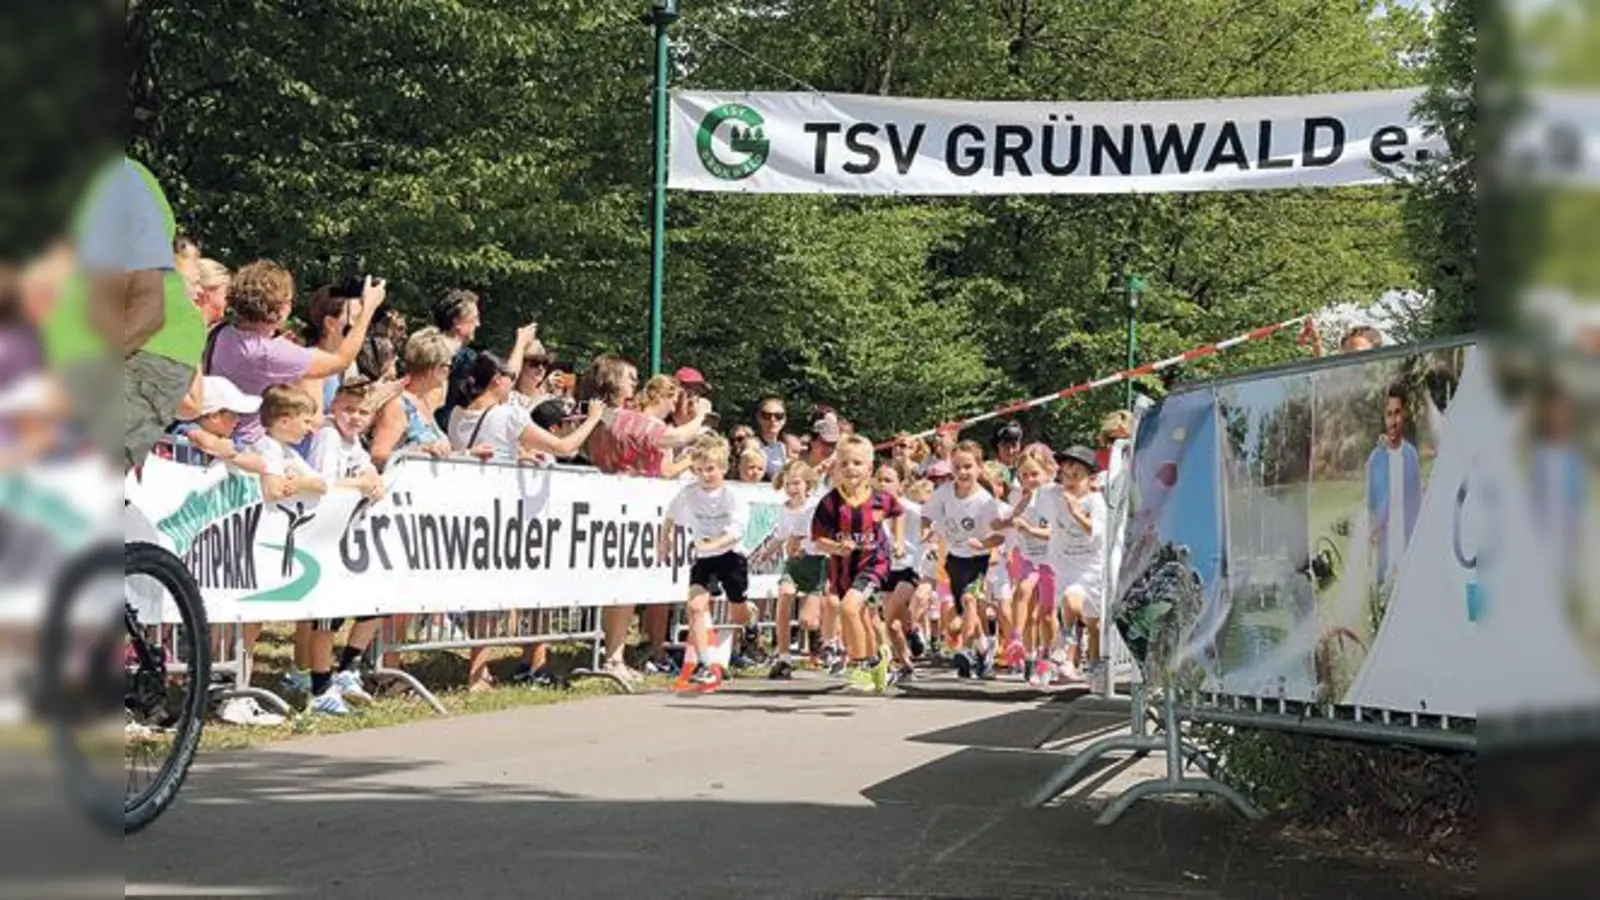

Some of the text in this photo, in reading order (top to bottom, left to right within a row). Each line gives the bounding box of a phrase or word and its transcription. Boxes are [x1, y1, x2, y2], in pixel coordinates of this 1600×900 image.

[804, 122, 926, 175] TSV
[945, 114, 1345, 176] GRÜNWALD
[183, 502, 263, 590] EITPARK
[339, 492, 562, 574] Grünwalder
